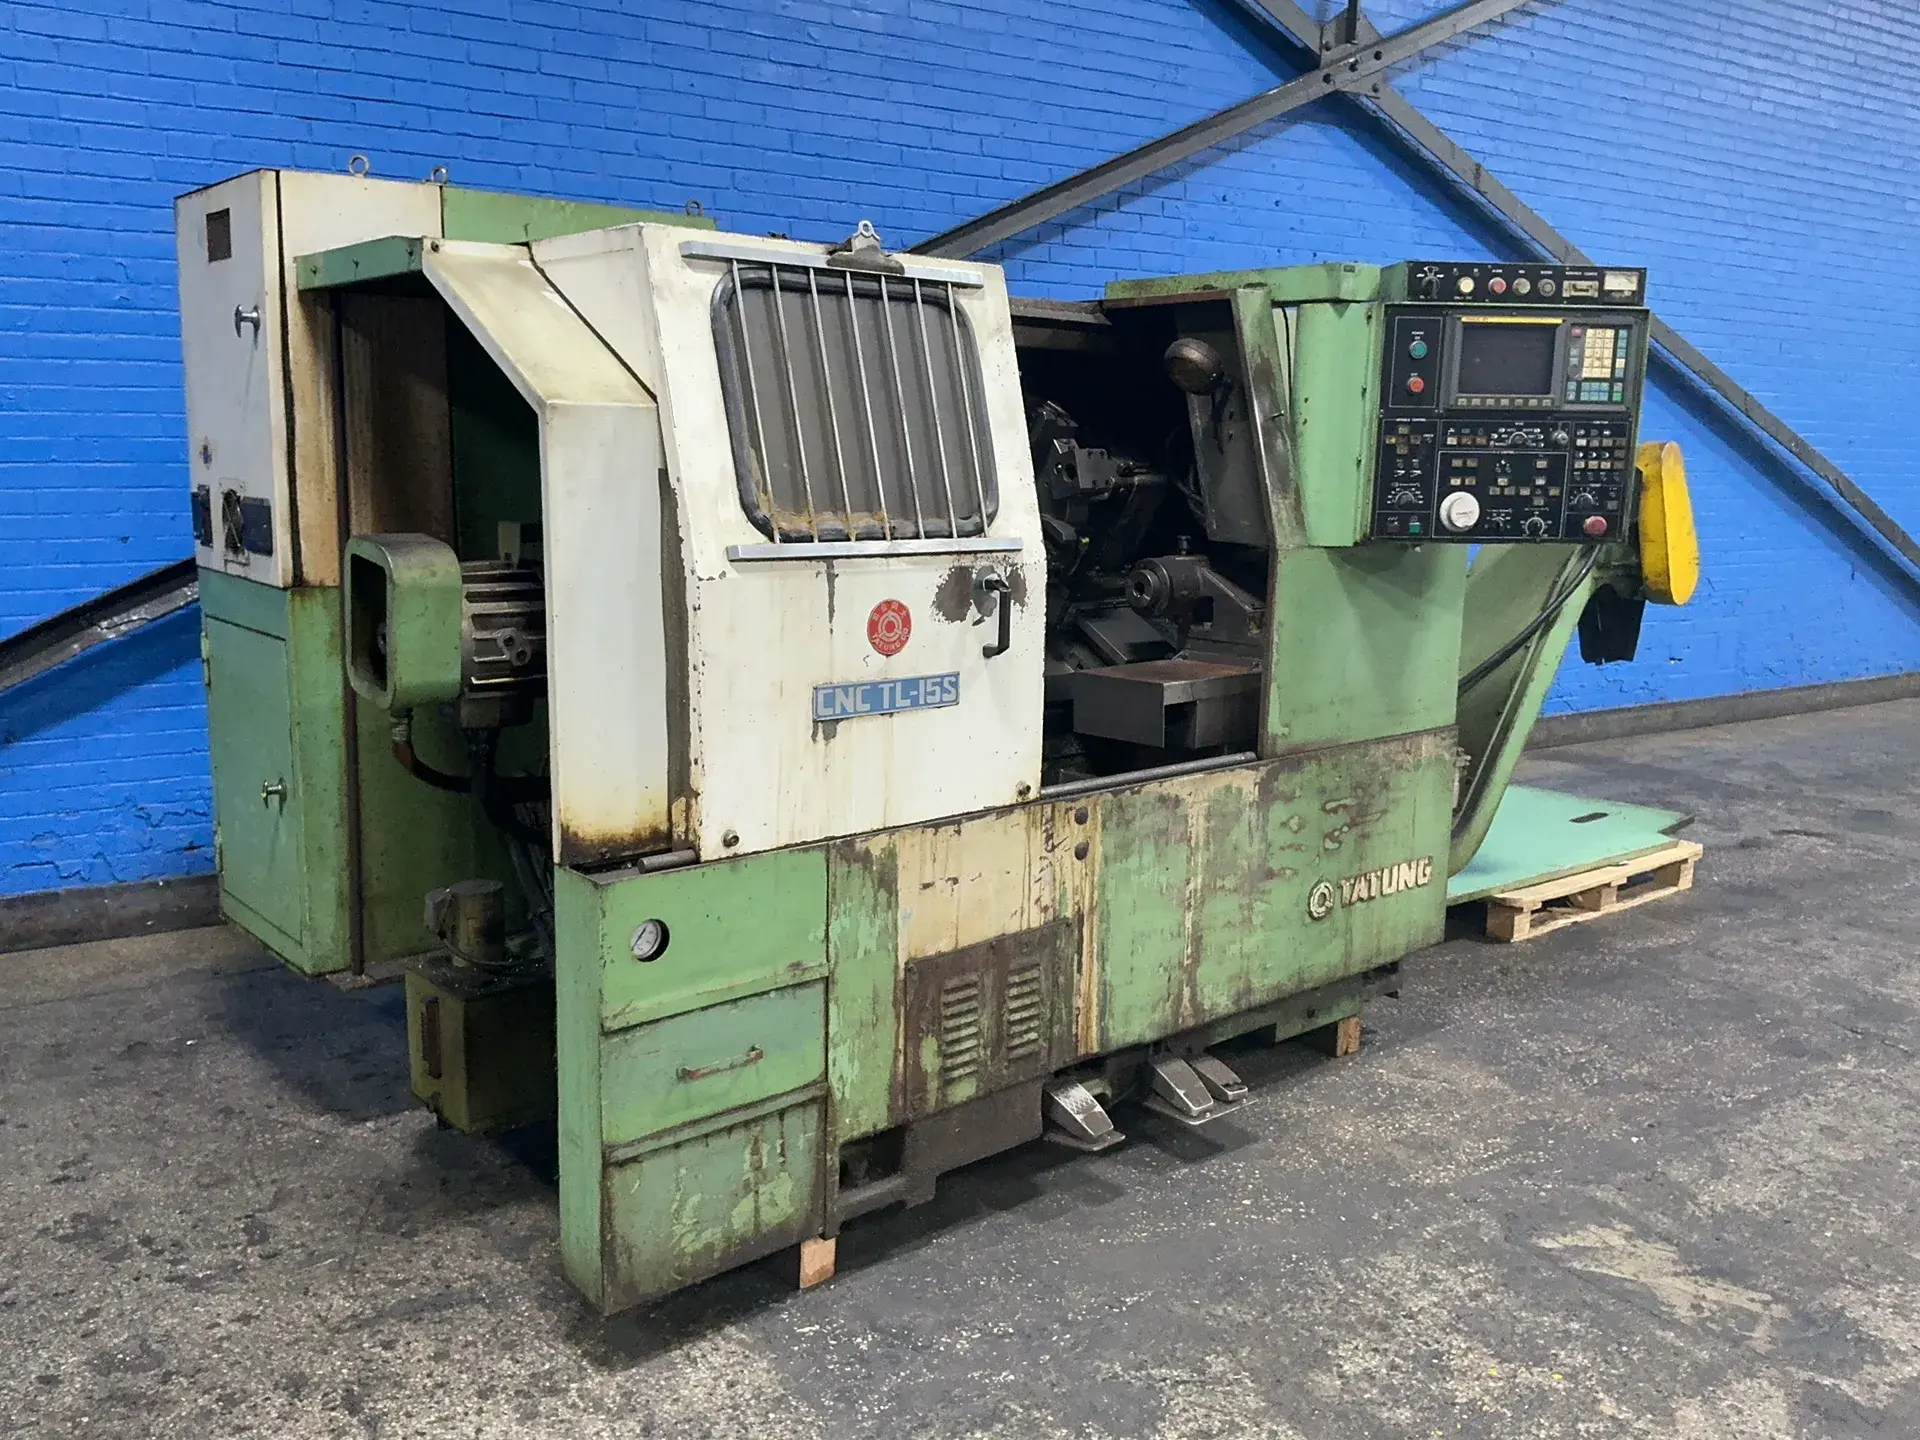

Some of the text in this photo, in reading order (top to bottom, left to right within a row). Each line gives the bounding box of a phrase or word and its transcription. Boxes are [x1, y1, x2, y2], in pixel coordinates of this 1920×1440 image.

[817, 676, 957, 716] CNC TL-15S
[1340, 857, 1433, 907] TATUNG
